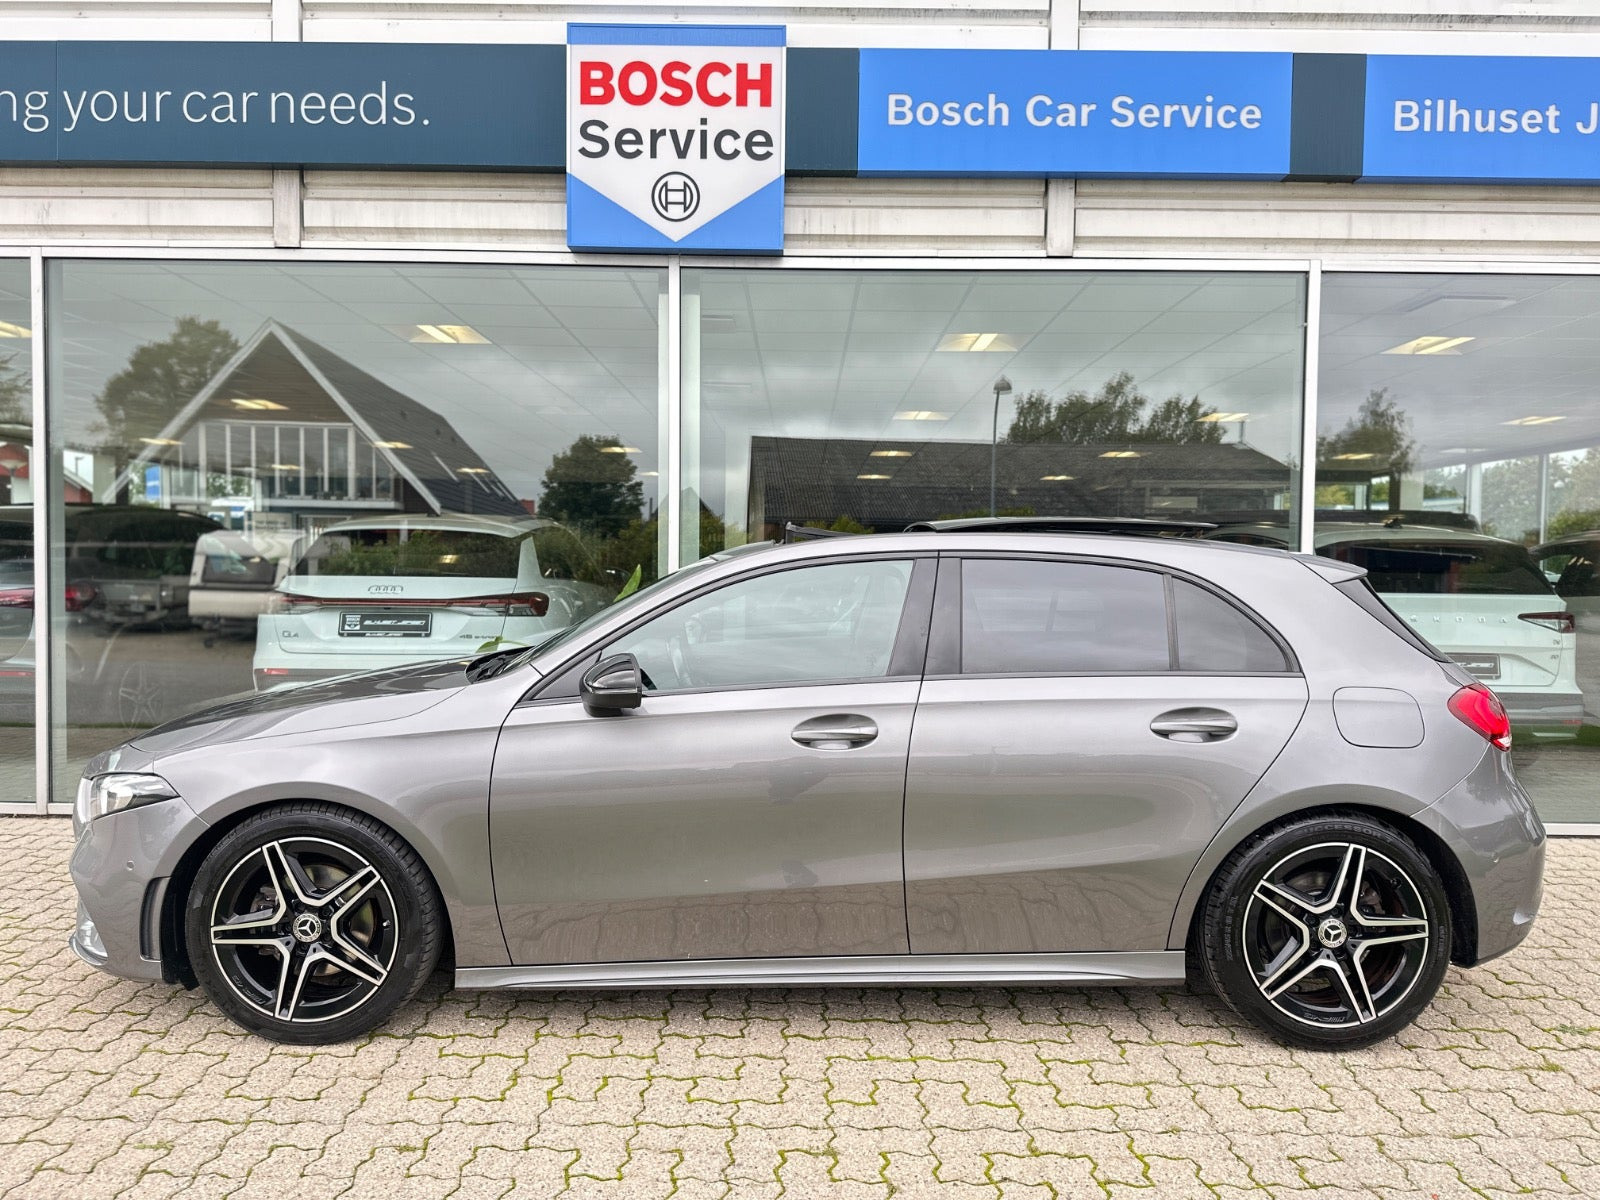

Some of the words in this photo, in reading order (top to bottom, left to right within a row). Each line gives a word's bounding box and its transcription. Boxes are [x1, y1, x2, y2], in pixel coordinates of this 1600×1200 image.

[0, 90, 50, 132] ng
[63, 90, 171, 132] your
[182, 90, 258, 123] car
[271, 81, 430, 126] needs.
[580, 61, 772, 108] BOSCH
[888, 93, 1009, 126] Bosch
[1026, 95, 1097, 127] Car
[1110, 95, 1262, 129] Service
[1394, 99, 1560, 134] Bilhuset
[578, 117, 774, 162] Service
